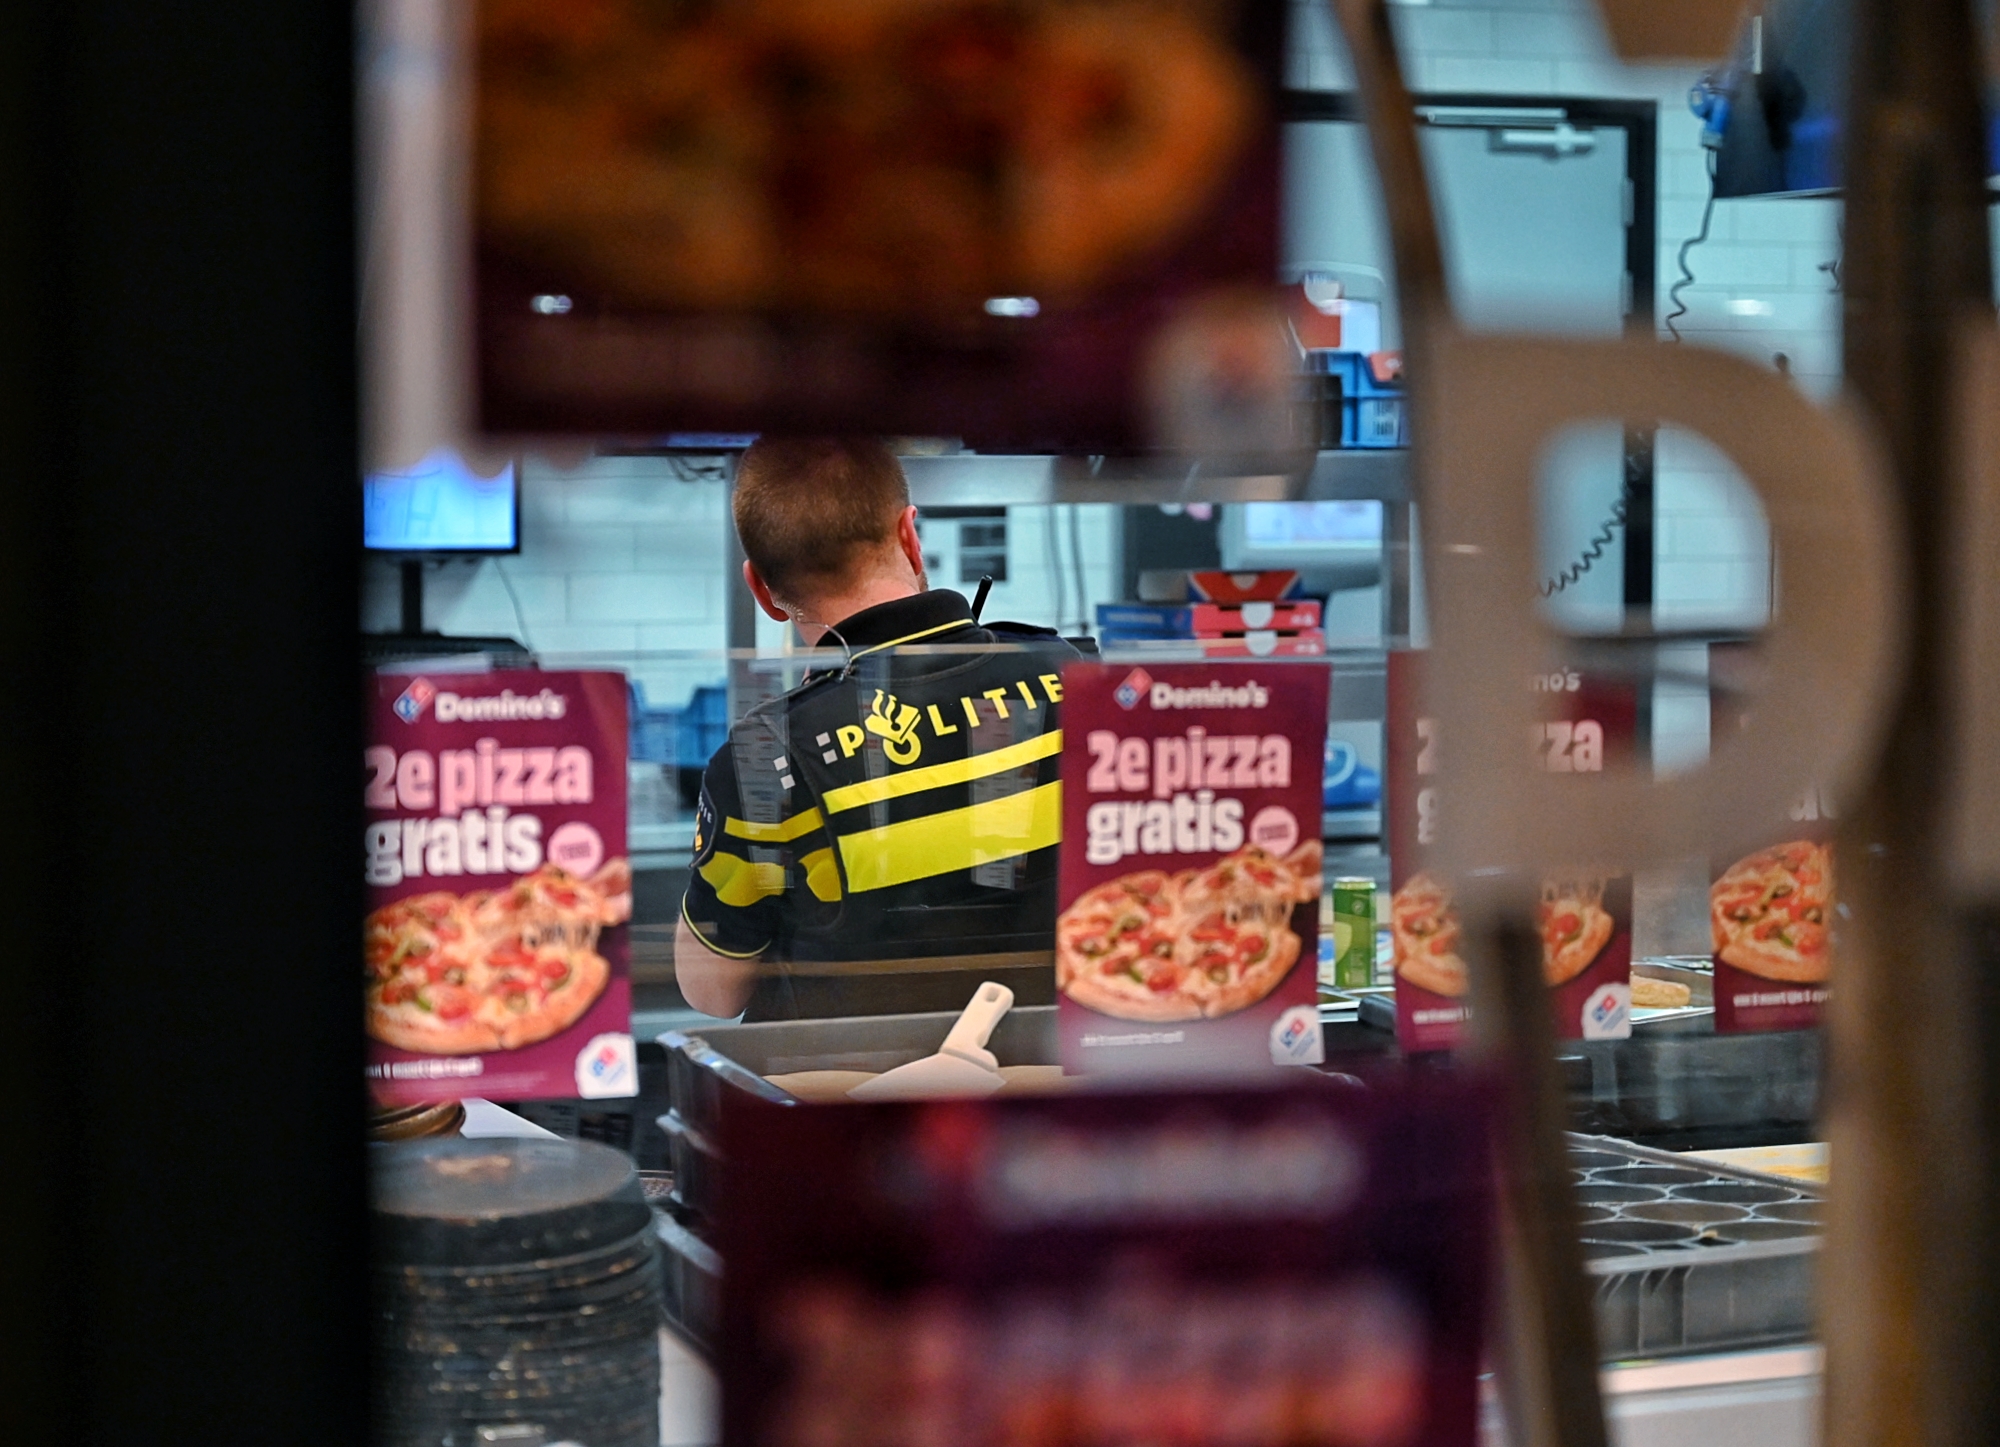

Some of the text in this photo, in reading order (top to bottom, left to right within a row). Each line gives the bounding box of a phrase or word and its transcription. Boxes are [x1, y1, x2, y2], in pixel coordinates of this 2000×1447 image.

[435, 688, 566, 722] Domino's
[836, 674, 1063, 765] POLITIE
[1151, 681, 1269, 709] Domino's
[364, 738, 594, 815] 2e pizza
[1087, 725, 1291, 798] 2e pizza
[364, 805, 543, 886] gratis
[1086, 789, 1244, 865] gratis
